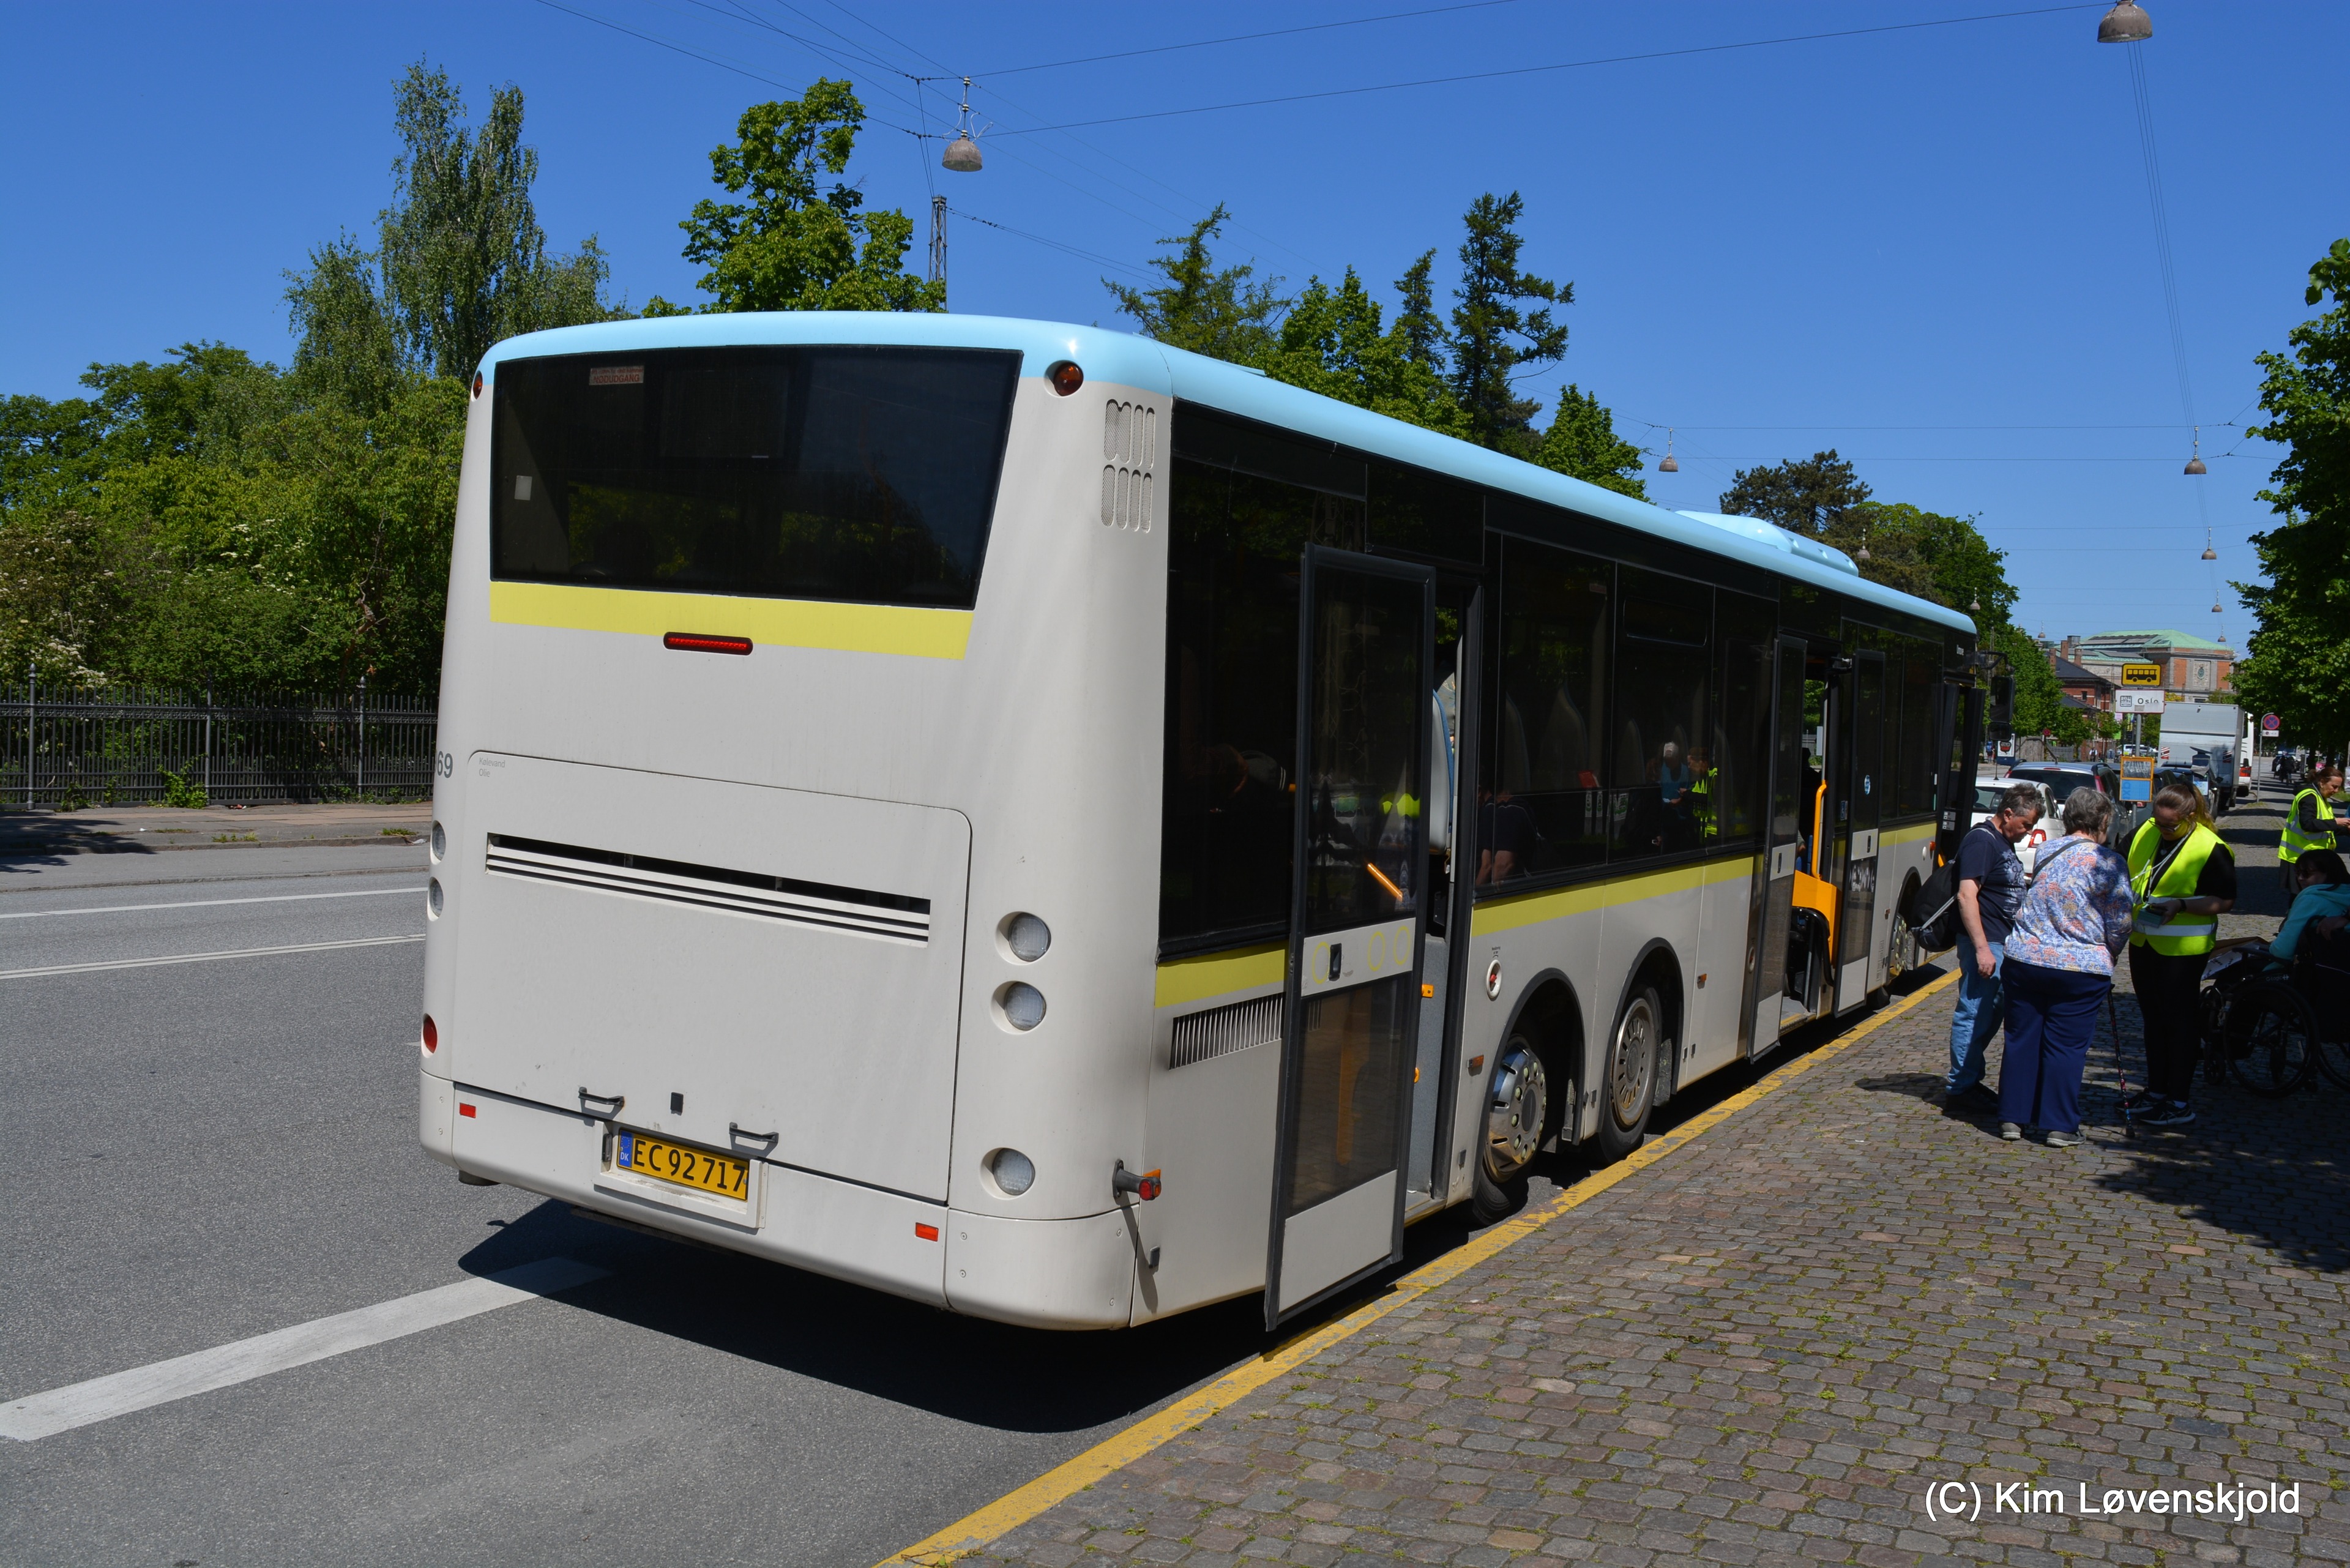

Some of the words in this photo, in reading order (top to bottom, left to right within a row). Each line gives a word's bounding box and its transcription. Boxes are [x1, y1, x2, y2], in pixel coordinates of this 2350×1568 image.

[479, 757, 506, 768] Kølevand
[479, 768, 490, 777] Olie
[620, 1151, 630, 1162] DK
